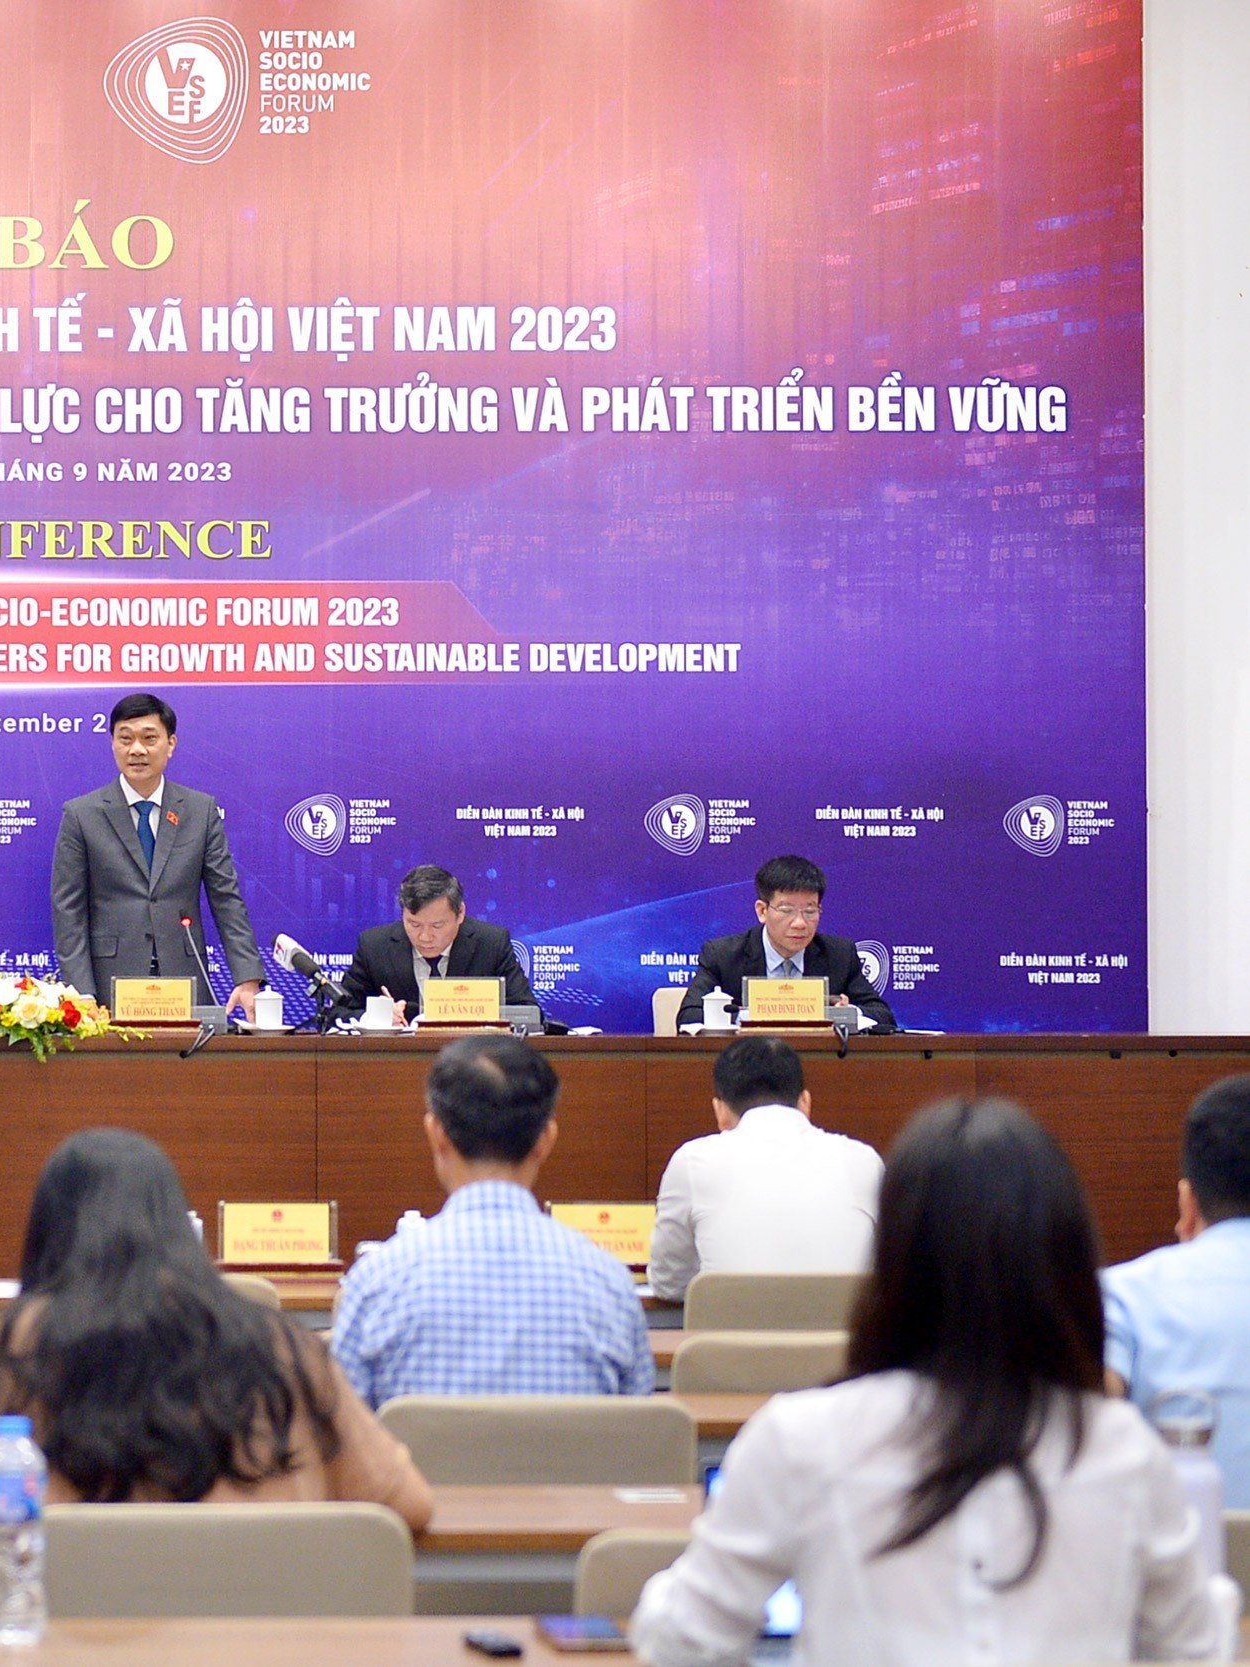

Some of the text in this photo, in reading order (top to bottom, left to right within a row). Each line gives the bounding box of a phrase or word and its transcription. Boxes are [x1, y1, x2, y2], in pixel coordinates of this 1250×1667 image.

[259, 30, 355, 49] VIETNAM
[259, 51, 323, 70] SOCIO
[260, 72, 371, 91] ECONOMIC
[260, 94, 334, 113] FORUM
[259, 115, 310, 134] 2023
[31, 291, 87, 353] TẾ
[127, 296, 189, 353] XÃ
[200, 296, 274, 363] HỘI
[286, 295, 381, 363] VIỆT
[393, 305, 497, 352] NAM
[509, 305, 617, 353] 2023
[94, 386, 183, 435] CHO
[194, 377, 311, 434] TĂNG
[323, 370, 499, 434] TRƯỞNG
[510, 376, 570, 433] VÀ
[581, 376, 695, 433] PHÁT
[705, 366, 834, 432] TRIỂN
[847, 370, 936, 432] BỀN
[947, 376, 1067, 433] VỮNG
[73, 462, 87, 482] 9
[97, 458, 158, 482] NĂM
[167, 462, 232, 482] 2023
[216, 596, 320, 627] FORUM
[327, 596, 400, 627] 2023
[56, 642, 113, 673] FOR
[120, 642, 246, 673] GROWTH
[252, 642, 316, 673] AND
[323, 642, 521, 673] SUSTAINABLE
[528, 642, 742, 673] DEVELOPMENT
[1067, 801, 1108, 809] VIETNAM
[1067, 809, 1095, 818] SOCIO
[1068, 818, 1114, 827] ECONOMIC
[1067, 827, 1100, 836] FORUM
[1067, 836, 1090, 845] 2023
[892, 946, 933, 954] VIETNAM
[892, 954, 920, 964] SOCIO
[893, 963, 939, 972] ECONOMIC
[893, 972, 925, 981] FORUM
[893, 981, 915, 990] 2023
[158, 1006, 186, 1017] THANH
